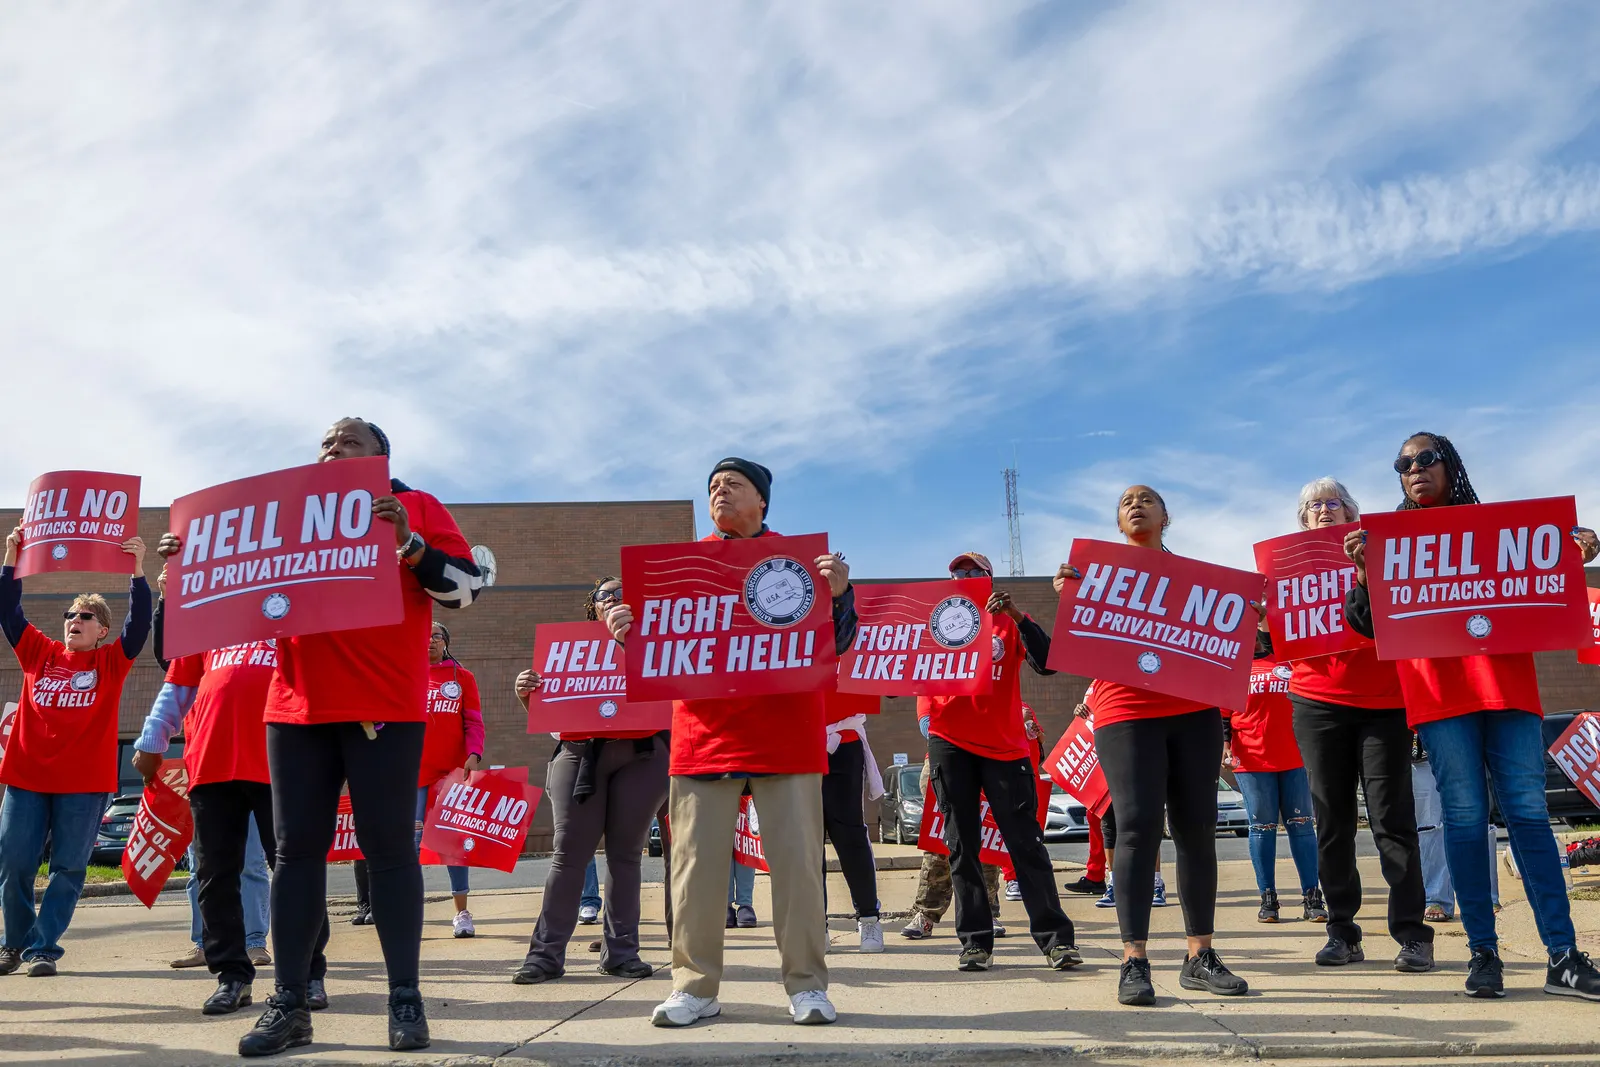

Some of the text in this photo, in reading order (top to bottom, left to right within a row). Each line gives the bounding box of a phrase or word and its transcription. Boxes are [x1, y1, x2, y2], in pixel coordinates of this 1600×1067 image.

[23, 488, 128, 524] HELL NO
[24, 521, 125, 540] TO ATTACKS ON US!
[182, 489, 374, 567] HELL NO
[181, 545, 379, 596] TO PRIVATIZATION!
[1383, 524, 1562, 581] HELL NO
[747, 564, 812, 622] NATIONAL ASSOCIATION OF LETTER CARRIERS
[1076, 563, 1245, 633] HELL NO
[1277, 567, 1356, 609] FIGHT
[1390, 574, 1565, 605] TO ATTACKS ON US!
[641, 595, 739, 636] FIGHT
[1072, 605, 1241, 660] TO PRIVATIZATION!
[1284, 603, 1345, 641] LIKE
[642, 630, 815, 678] LIKE HELL!
[854, 623, 927, 651] FIGHT
[211, 650, 248, 671] LIKE
[544, 639, 617, 673] HELL
[851, 654, 908, 680] LIKE
[912, 651, 979, 681] HELL!
[57, 692, 97, 708] HELL!
[542, 678, 560, 693] TO
[434, 700, 460, 714] HELL!
[1056, 733, 1092, 780] HELL
[1069, 774, 1081, 788] TO
[442, 783, 529, 825] HELL NO
[152, 831, 172, 851] TO
[440, 810, 519, 840] TO ATTACKS ON US!
